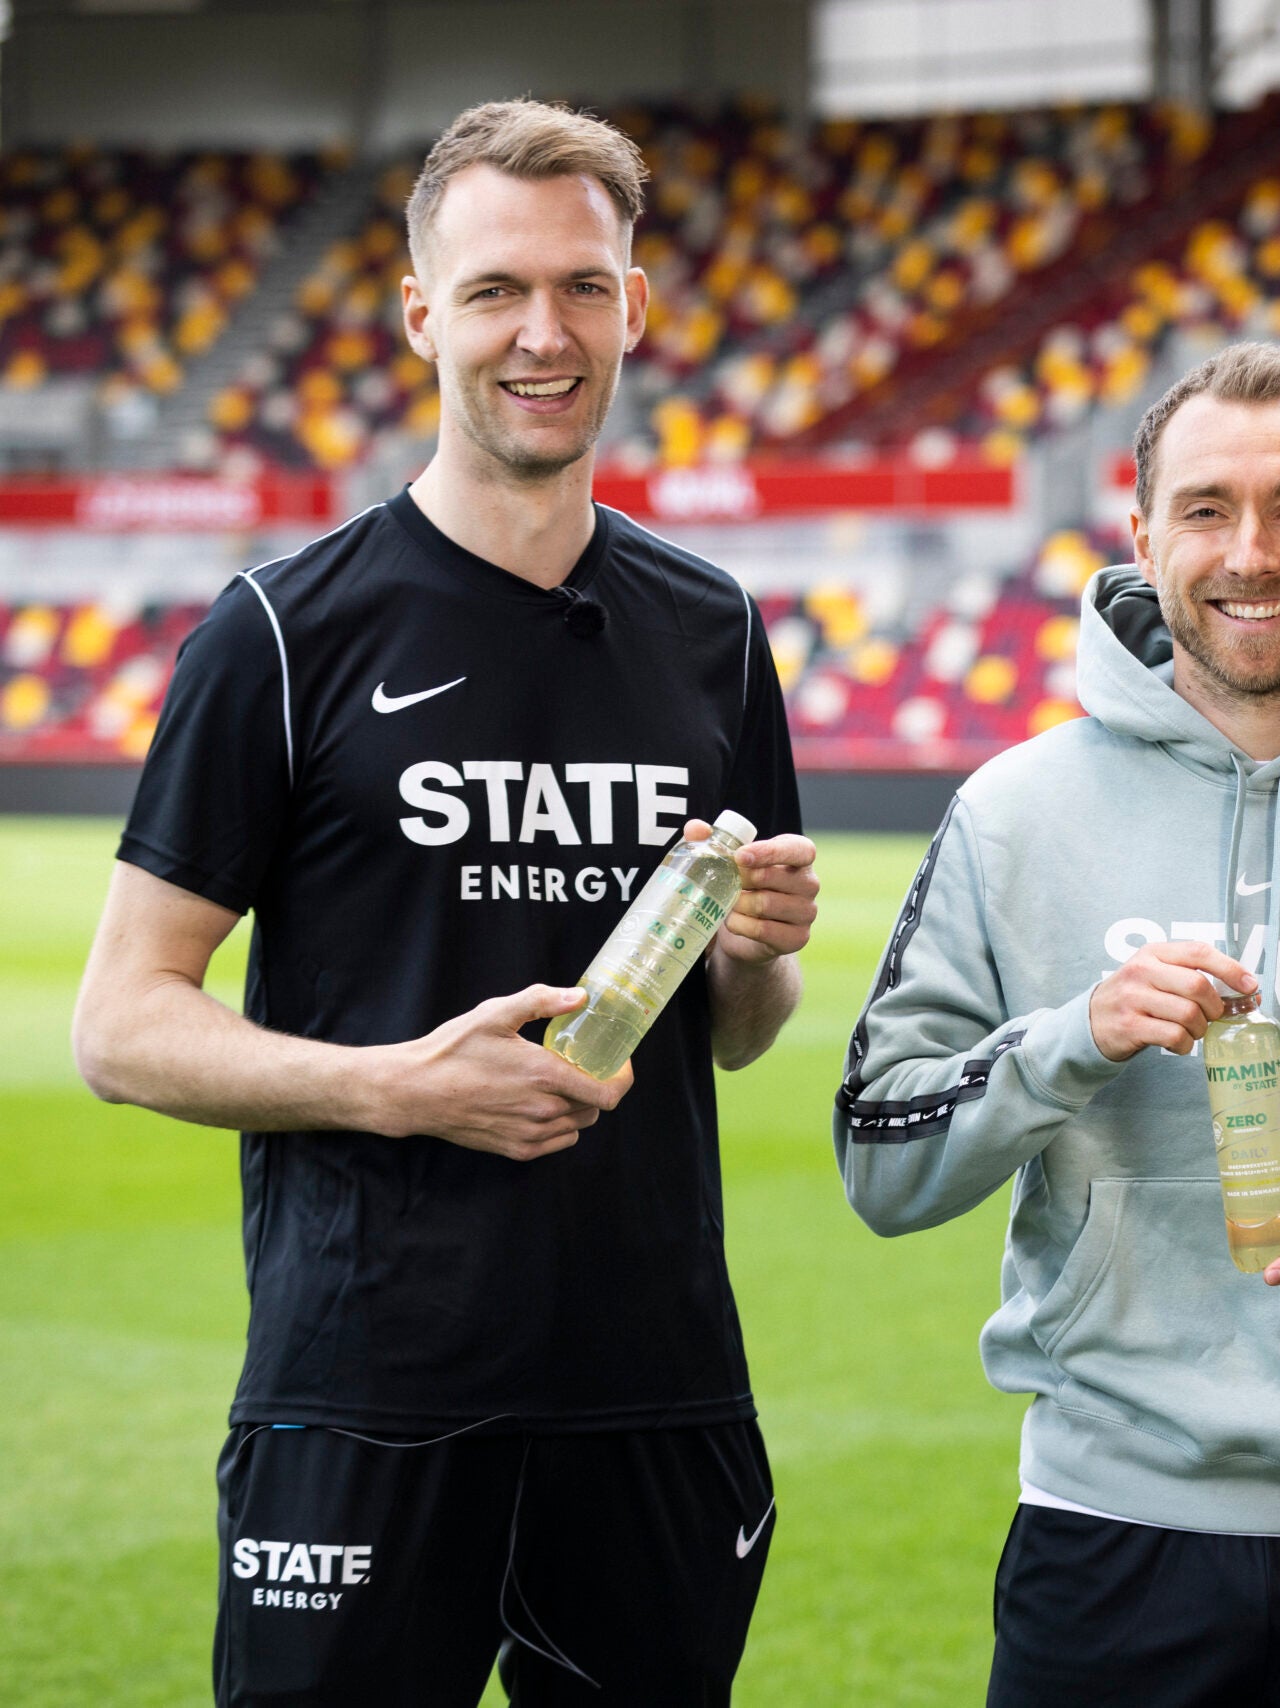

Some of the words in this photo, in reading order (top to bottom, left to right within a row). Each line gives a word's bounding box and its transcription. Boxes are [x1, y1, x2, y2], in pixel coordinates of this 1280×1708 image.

[399, 761, 689, 846] STATE
[461, 865, 639, 902] ENERGY
[1245, 1077, 1278, 1092] STATE
[887, 1117, 908, 1127] NIKE
[1226, 1113, 1268, 1128] ZERO
[1231, 1145, 1269, 1160] DAILY
[232, 1538, 372, 1584] STATE
[253, 1588, 343, 1610] ENERGY
